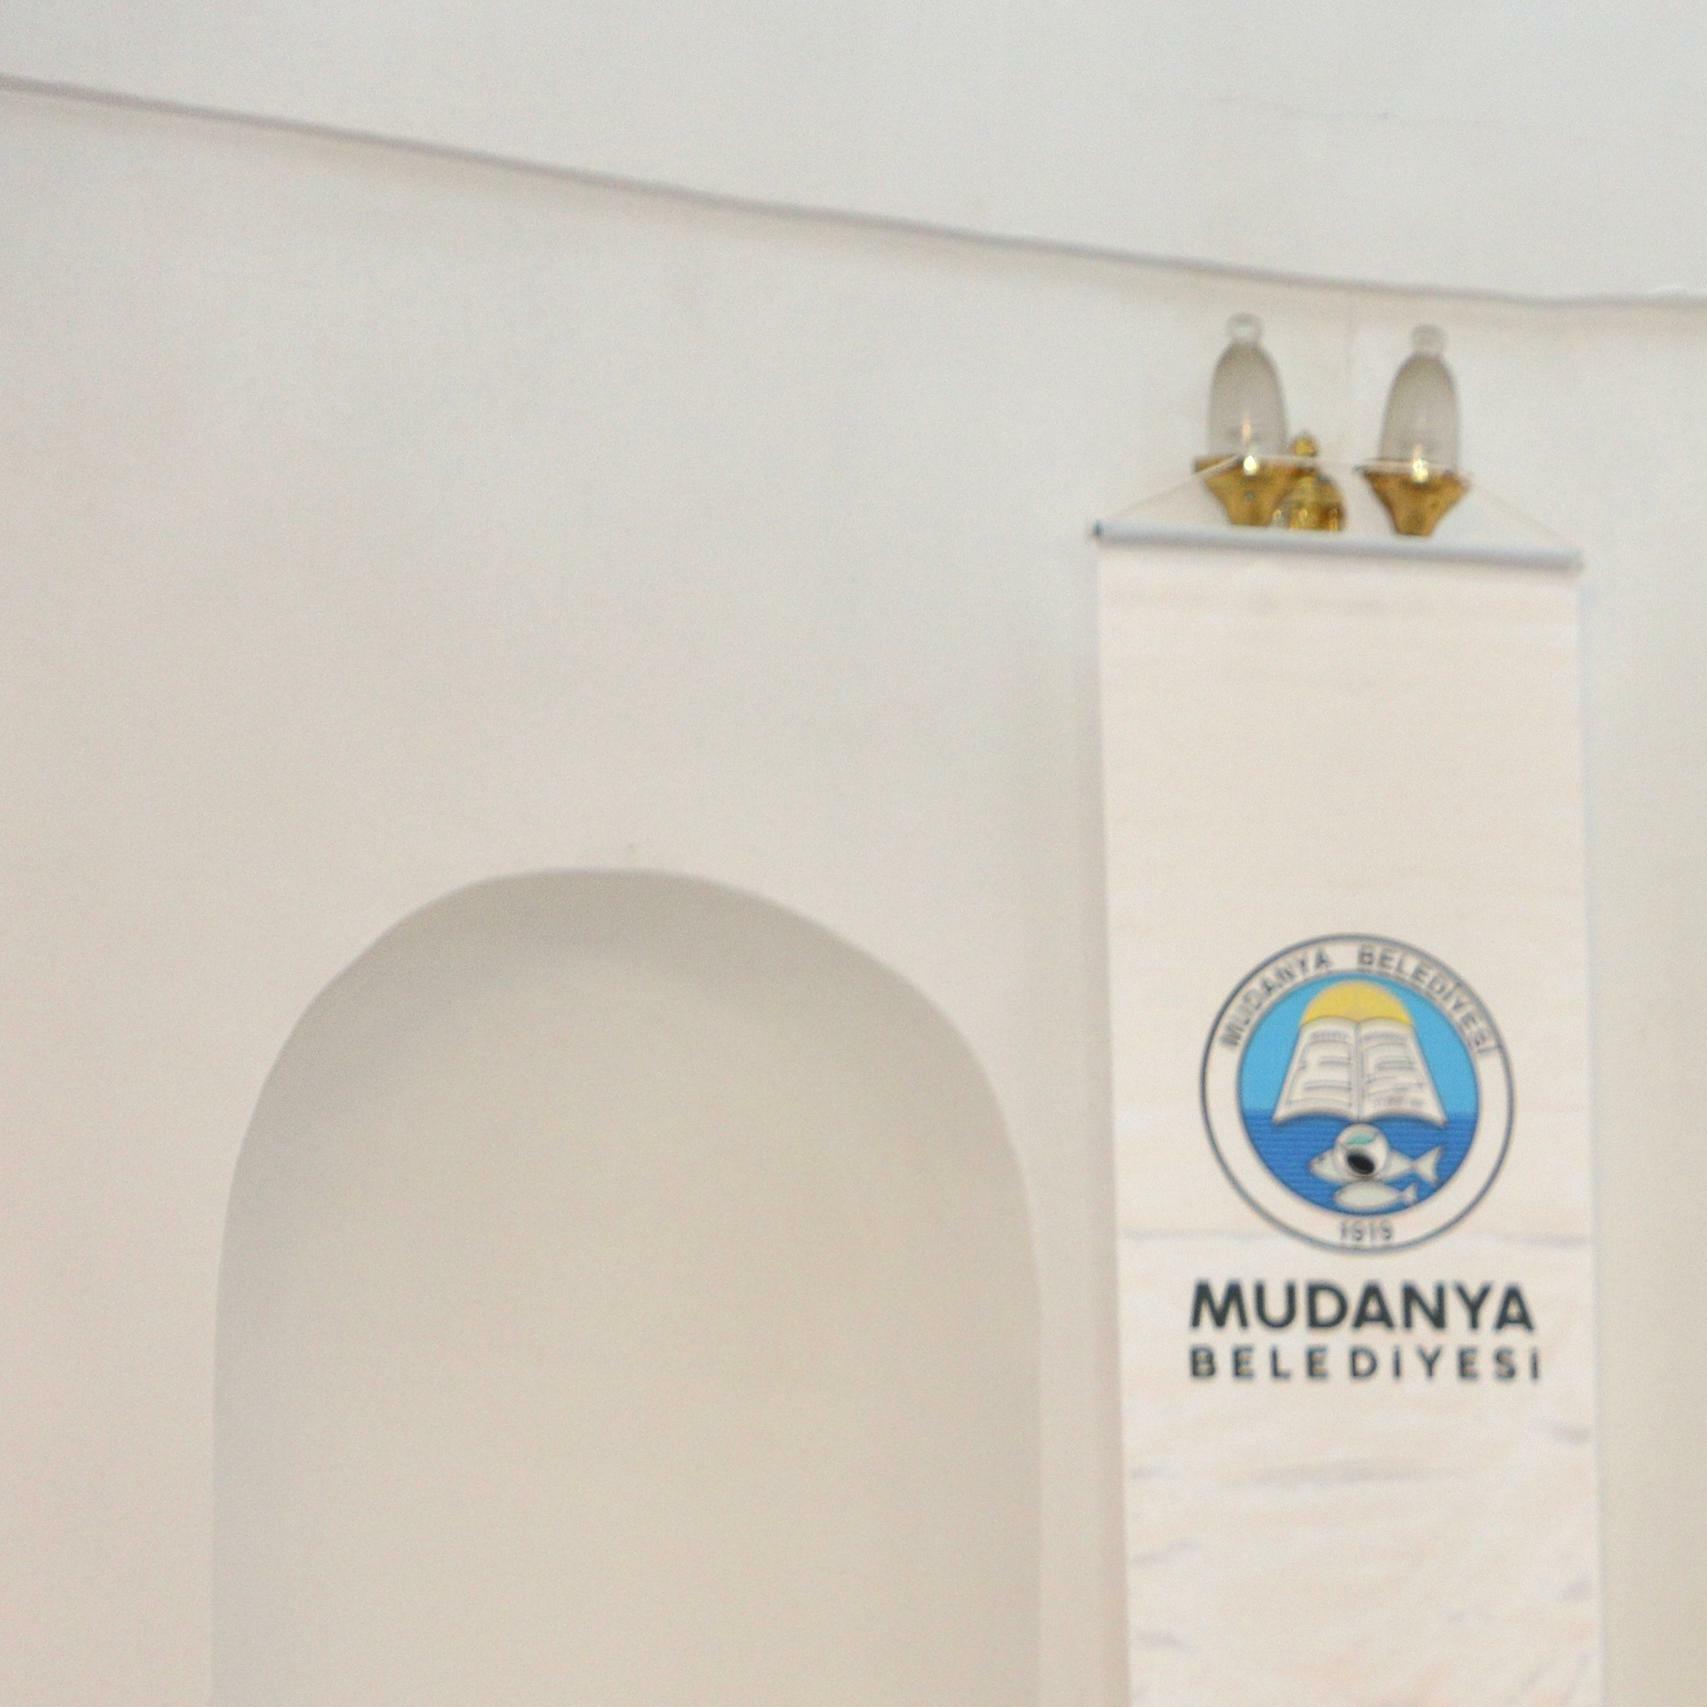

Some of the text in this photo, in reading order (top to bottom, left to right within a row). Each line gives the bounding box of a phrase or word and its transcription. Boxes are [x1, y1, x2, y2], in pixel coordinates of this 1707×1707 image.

[1223, 944, 1499, 1057] MUDANYA BELEDİYESİ
[1190, 1279, 1535, 1332] MUDANYA
[1190, 1345, 1540, 1381] BELEDİYESİ
